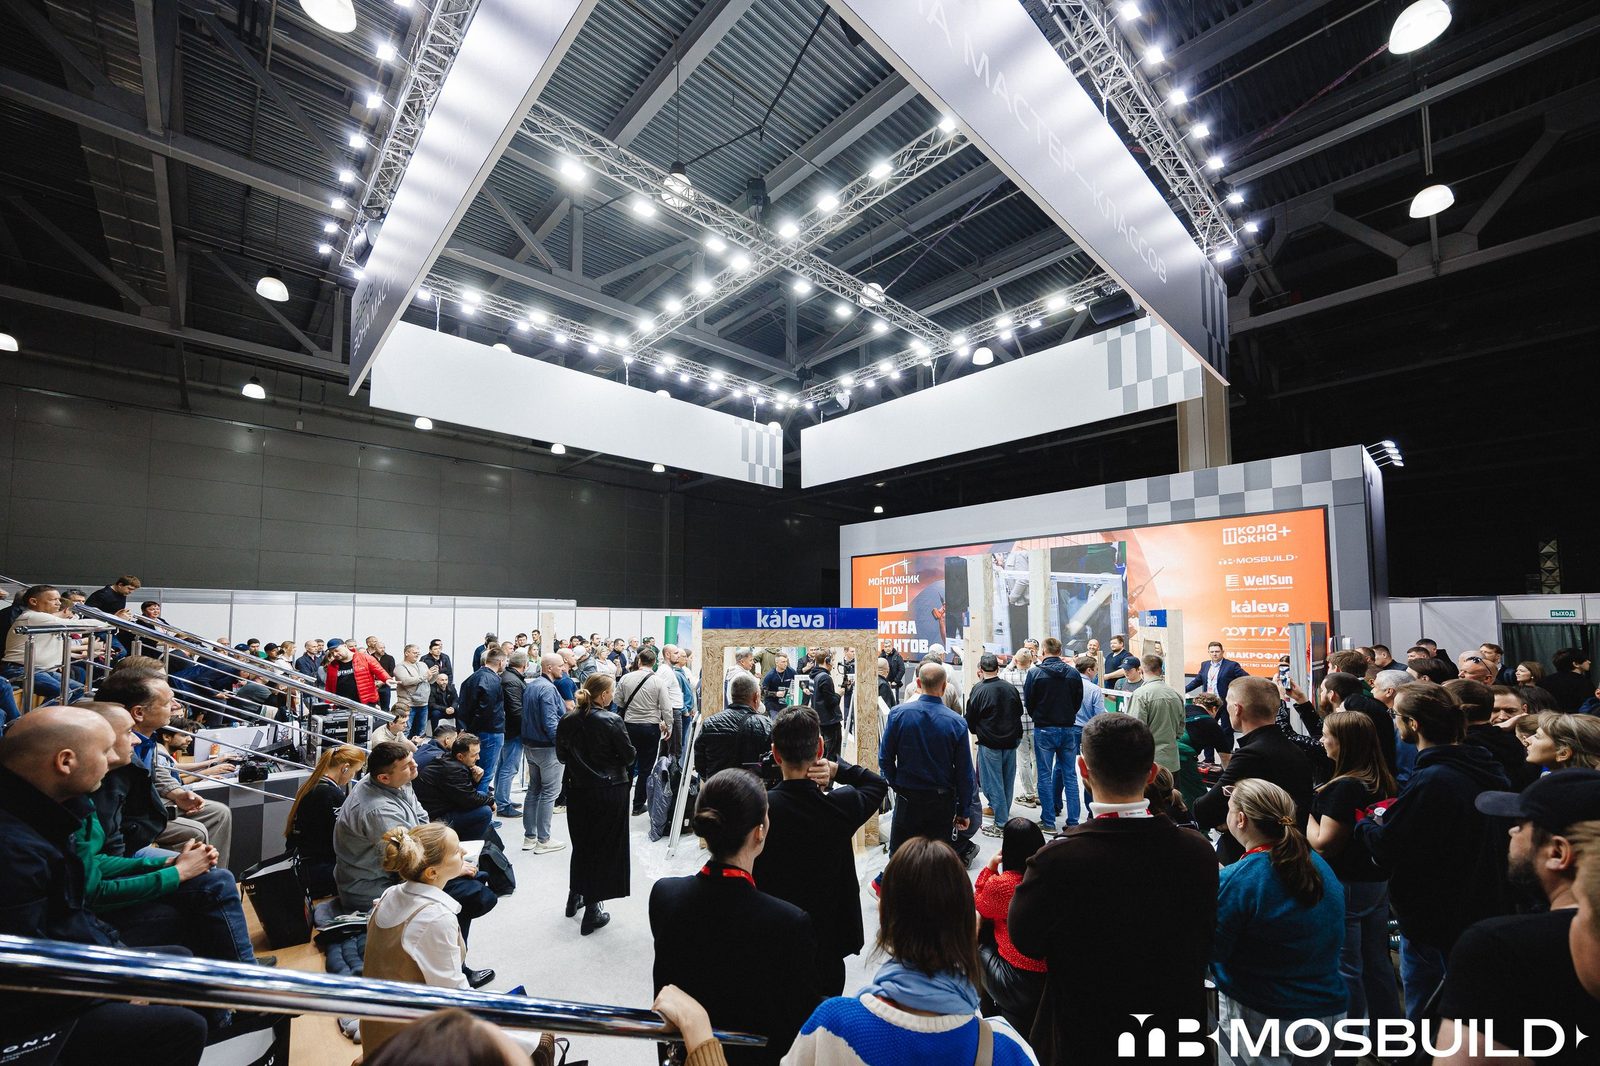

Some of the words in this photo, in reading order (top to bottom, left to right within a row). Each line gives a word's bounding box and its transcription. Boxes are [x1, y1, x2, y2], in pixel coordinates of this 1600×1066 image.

[1236, 554, 1295, 564] MOSBUILD
[868, 574, 920, 586] МОНТАЖНИК
[1243, 574, 1293, 586] WellSun
[884, 586, 904, 595] ШОУ
[878, 620, 918, 634] ИТВА
[1226, 651, 1290, 660] МАКРОФЛЕ
